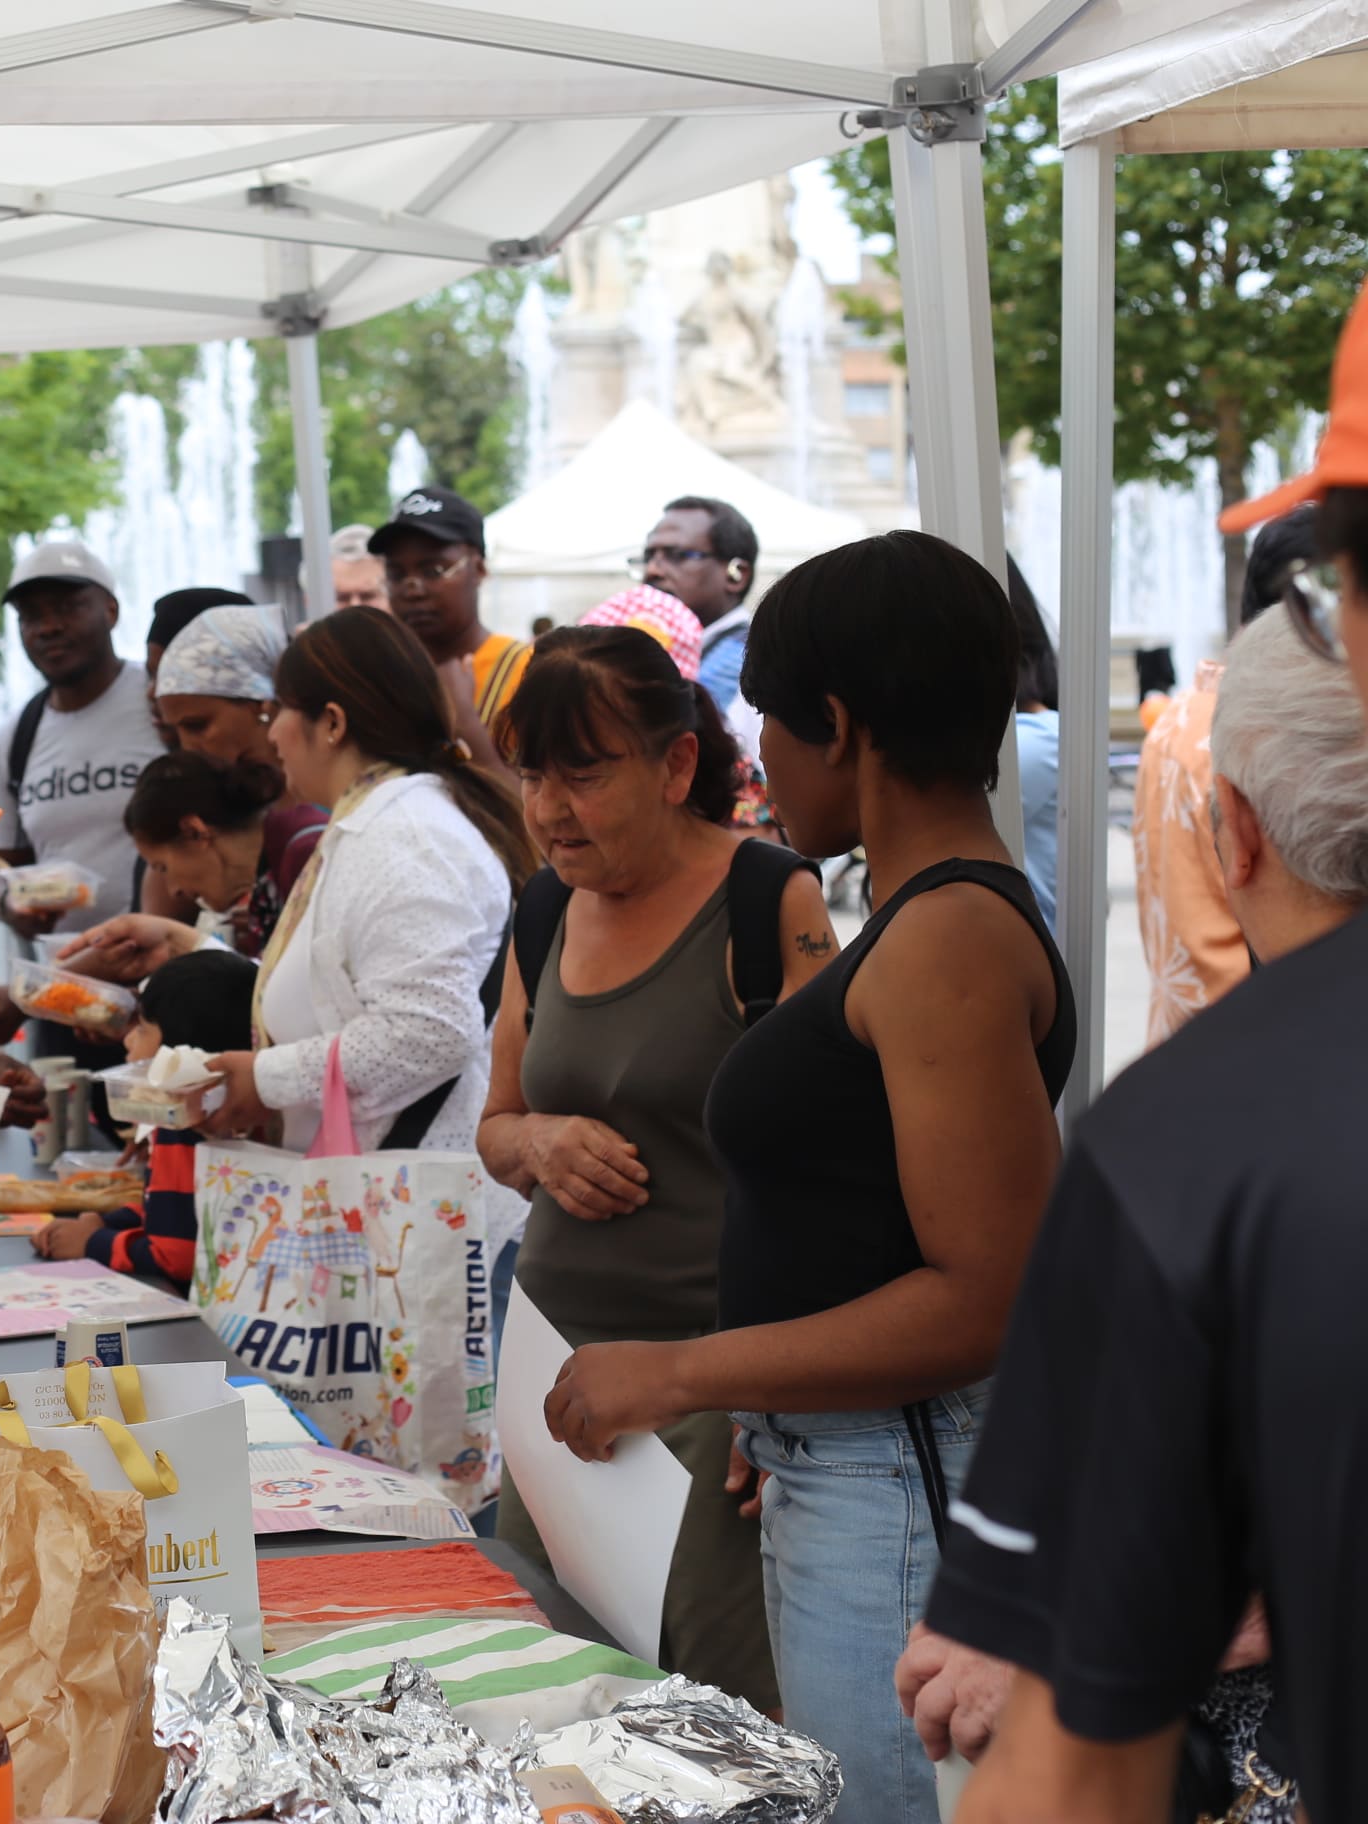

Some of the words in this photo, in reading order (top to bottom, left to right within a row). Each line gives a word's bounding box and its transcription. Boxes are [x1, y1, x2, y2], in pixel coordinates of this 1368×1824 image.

[466, 1239, 488, 1358] ACTION
[234, 1318, 382, 1378] ACTION
[148, 1527, 221, 1574] ubert
